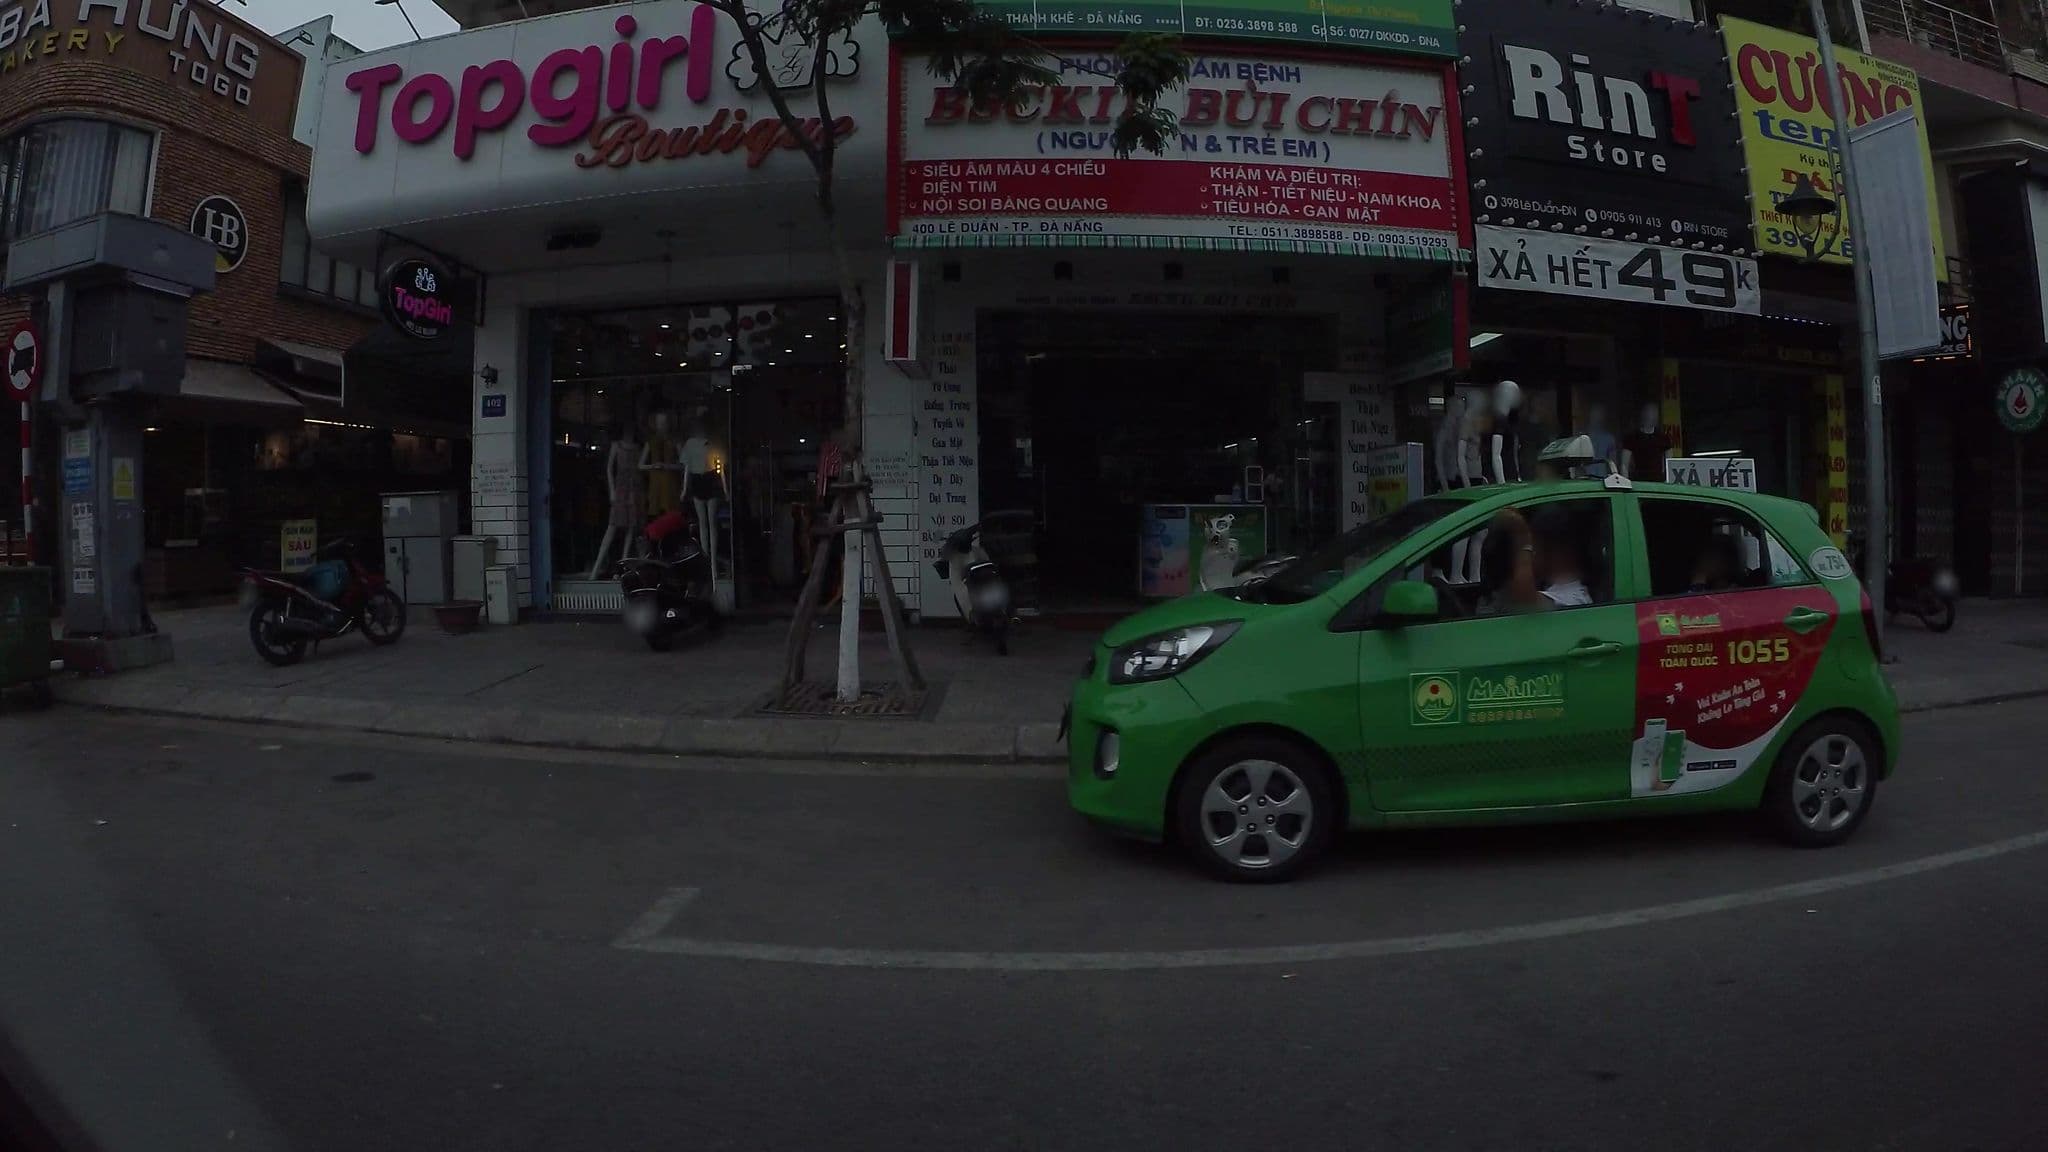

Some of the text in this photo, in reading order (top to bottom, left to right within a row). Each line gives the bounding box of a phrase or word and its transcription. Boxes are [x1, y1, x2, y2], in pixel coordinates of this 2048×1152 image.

[1006, 13, 1047, 25] THANH
[1216, 18, 1275, 32] 0236.3898
[0, 28, 125, 73] AKERY
[169, 49, 251, 105] TOGO
[345, 5, 715, 160] Topgirl
[1236, 61, 1301, 84] BỆNH
[1296, 88, 1441, 142] CHÍN
[575, 108, 856, 168] Boutique
[1205, 134, 1222, 153] &
[1567, 134, 1668, 174] Store
[1041, 163, 1050, 176] 4
[967, 181, 997, 193] TIM
[957, 198, 986, 212] SOI
[1045, 197, 1109, 212] QUANG
[1358, 191, 1394, 206] NAM
[1397, 195, 1442, 210] KHOA
[1500, 196, 1519, 210] 398
[1303, 204, 1339, 219] GAN
[1600, 209, 1662, 229] 0905 911 413
[912, 222, 935, 234] 400
[1229, 225, 1257, 236] TEL:
[1262, 227, 1343, 241] 0511.3898588
[1378, 233, 1449, 248] 0903.519293
[1683, 221, 1729, 239] RIN STORE
[1489, 238, 1537, 283] XẢ
[1547, 245, 1612, 290] HẾT
[1672, 461, 1753, 488] XẢ HẾT
[1727, 638, 1791, 665] 1055
